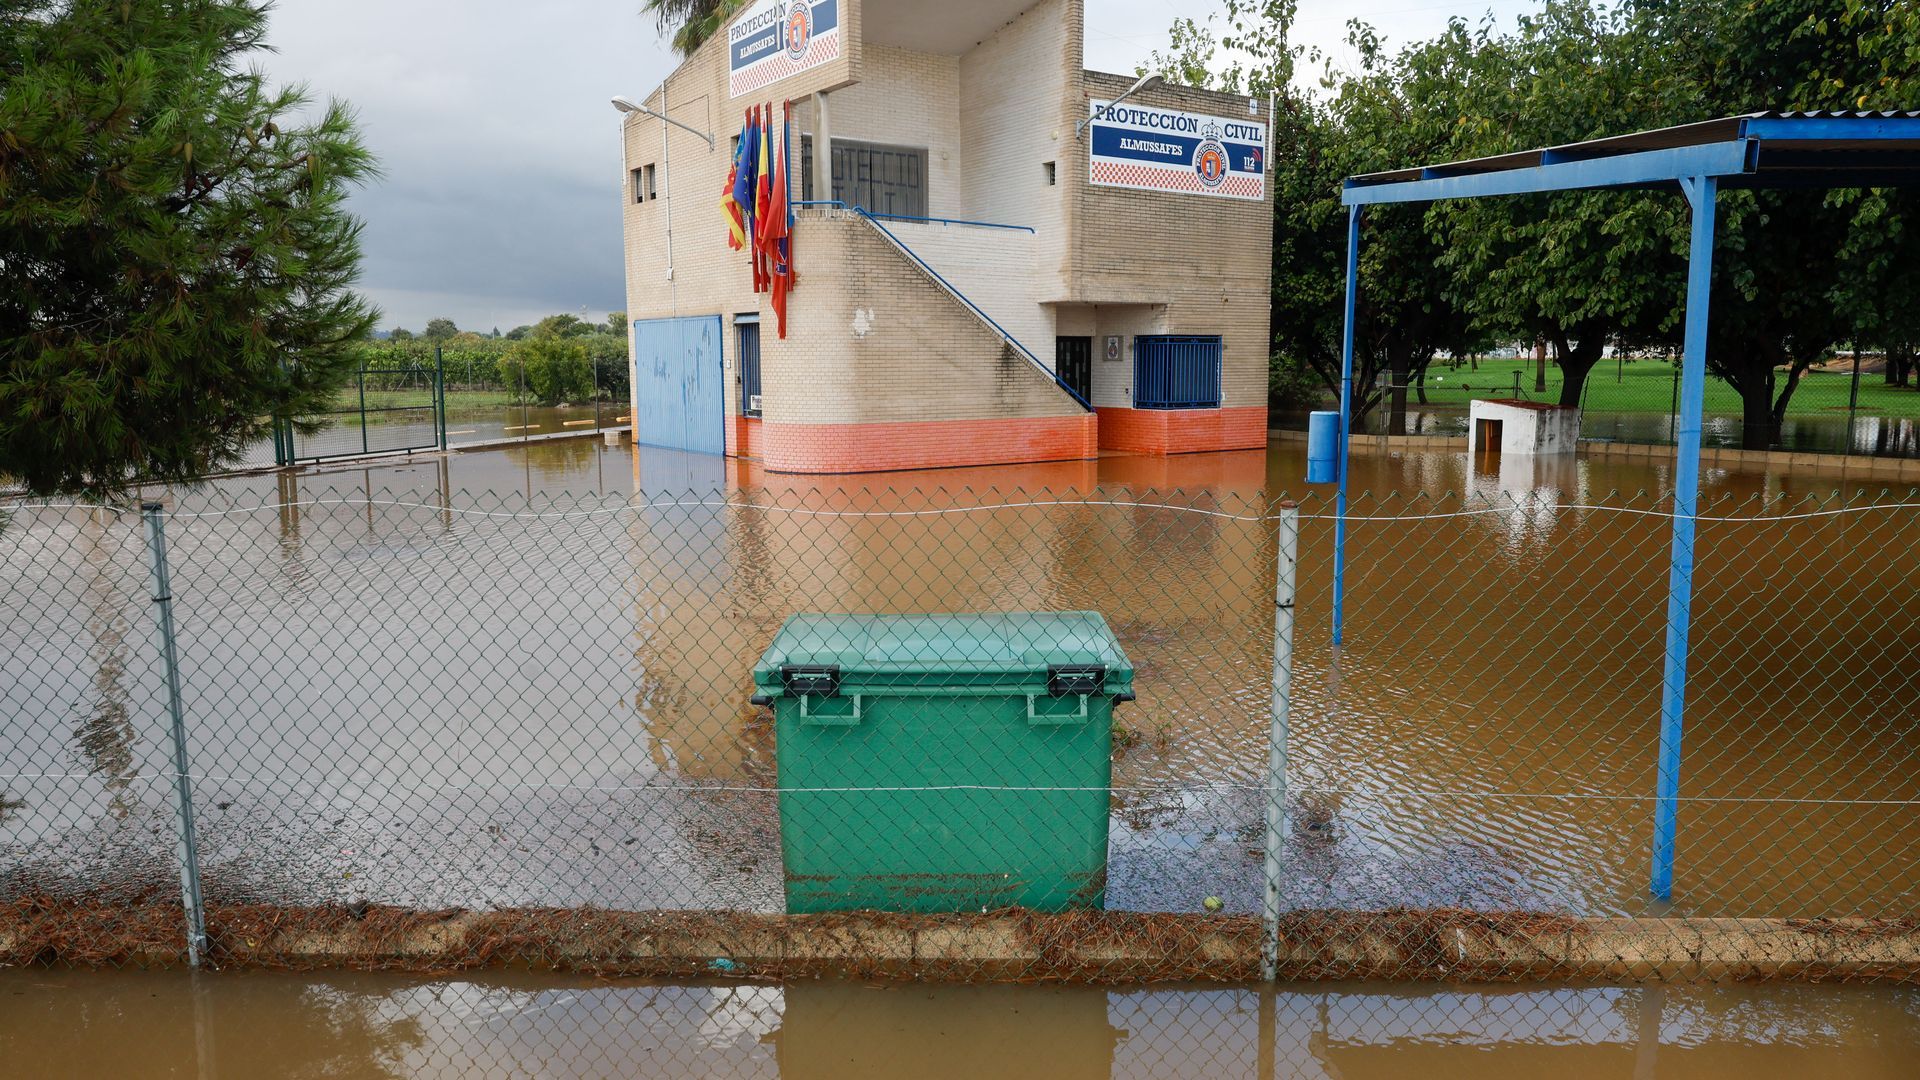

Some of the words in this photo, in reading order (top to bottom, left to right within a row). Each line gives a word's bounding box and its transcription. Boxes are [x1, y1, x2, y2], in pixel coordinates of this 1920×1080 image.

[1095, 104, 1199, 133] PROTECCIÓN
[1224, 123, 1262, 142] CIVIL
[1119, 138, 1183, 156] ALMUSSAFES
[1243, 156, 1255, 167] 112
